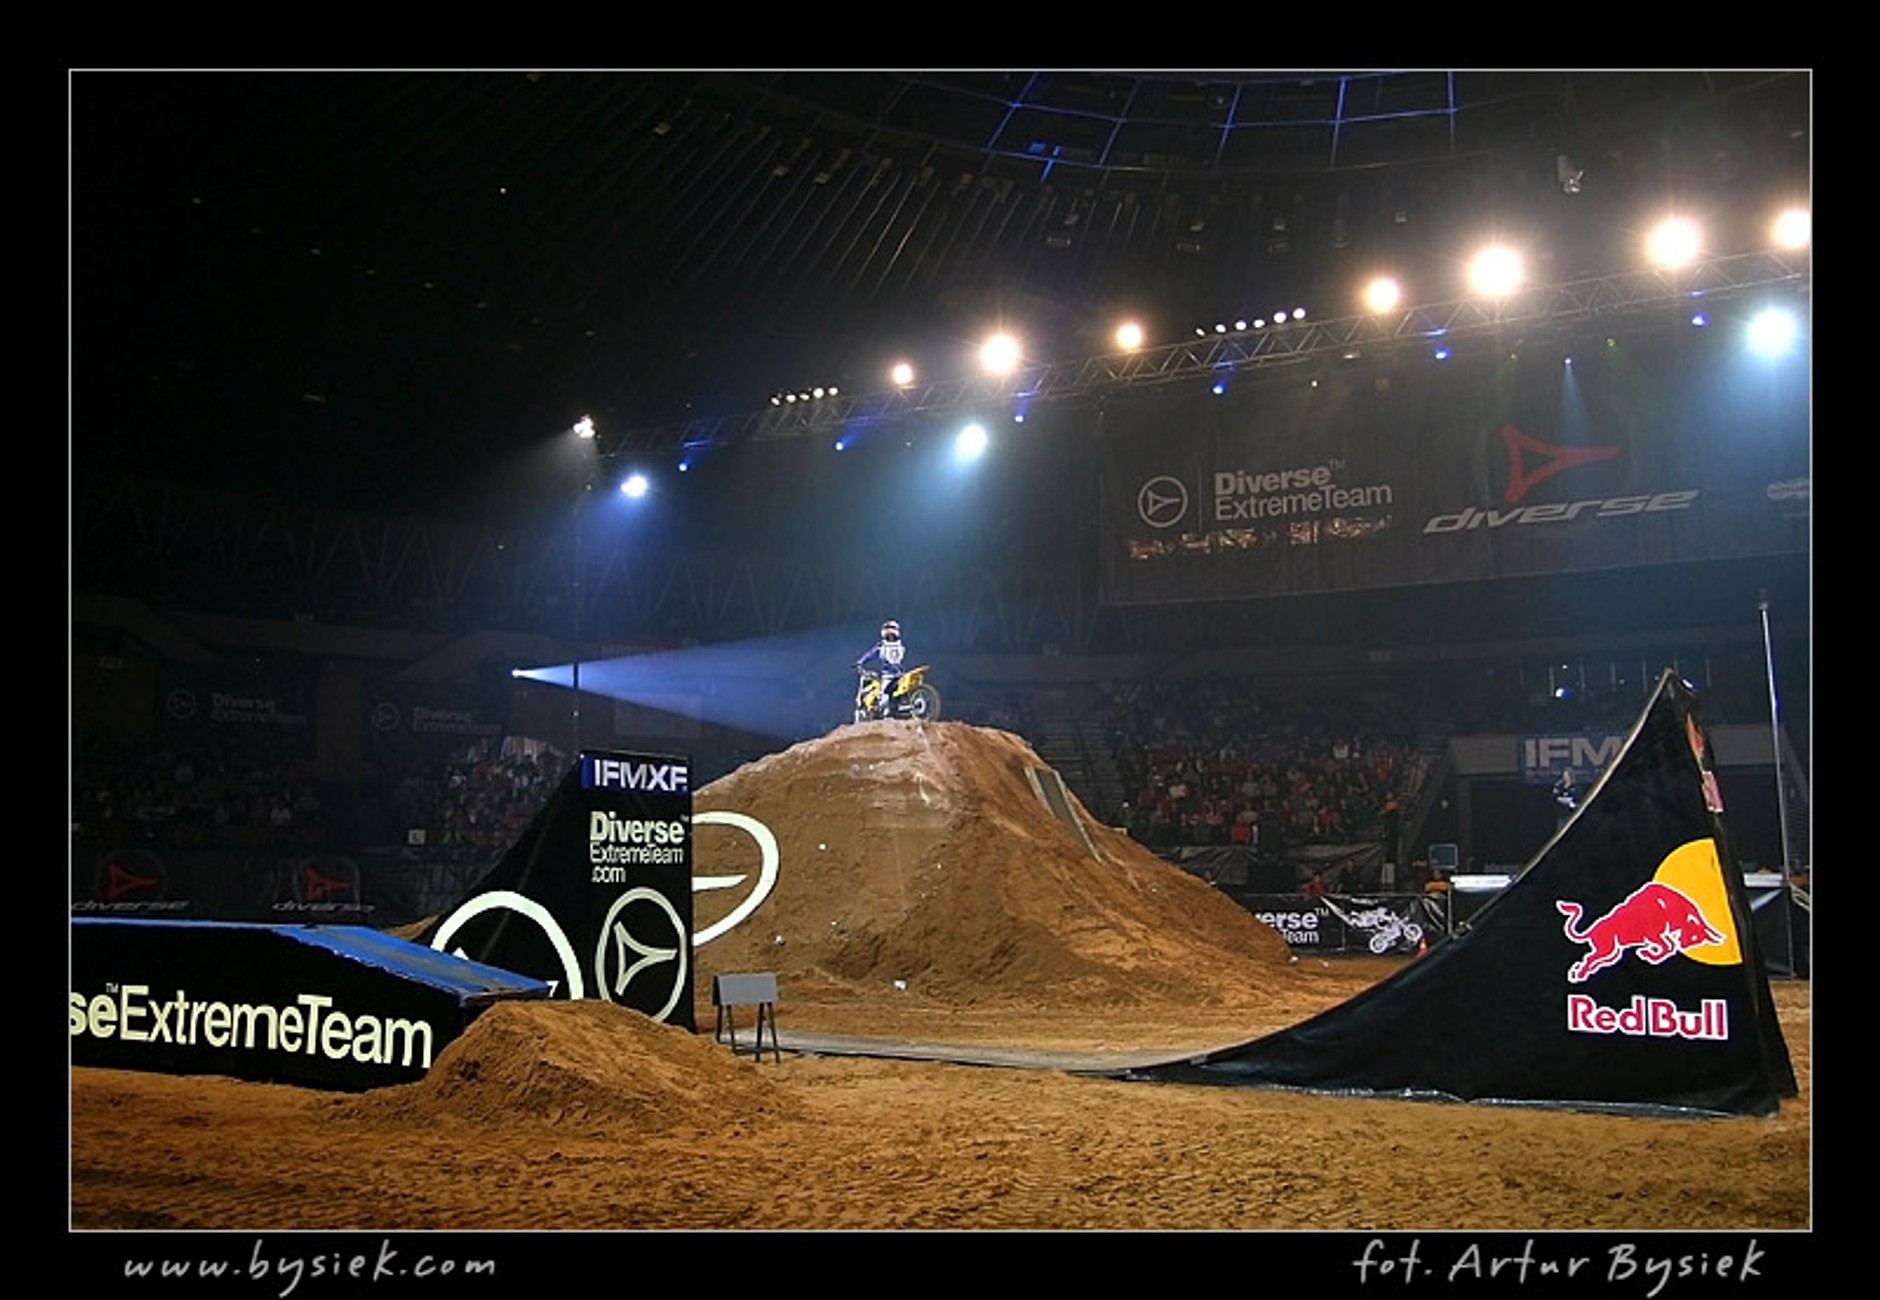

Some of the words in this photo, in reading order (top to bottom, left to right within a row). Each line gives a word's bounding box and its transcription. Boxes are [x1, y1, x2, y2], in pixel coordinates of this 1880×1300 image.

[1214, 466, 1332, 495] Diverse
[1215, 484, 1393, 520] ExtremeTeam
[1423, 489, 1699, 533] diverse
[590, 811, 685, 844] Diverse
[590, 842, 684, 864] ExtremeTeam
[120, 984, 432, 1069] ExtremeTeam
